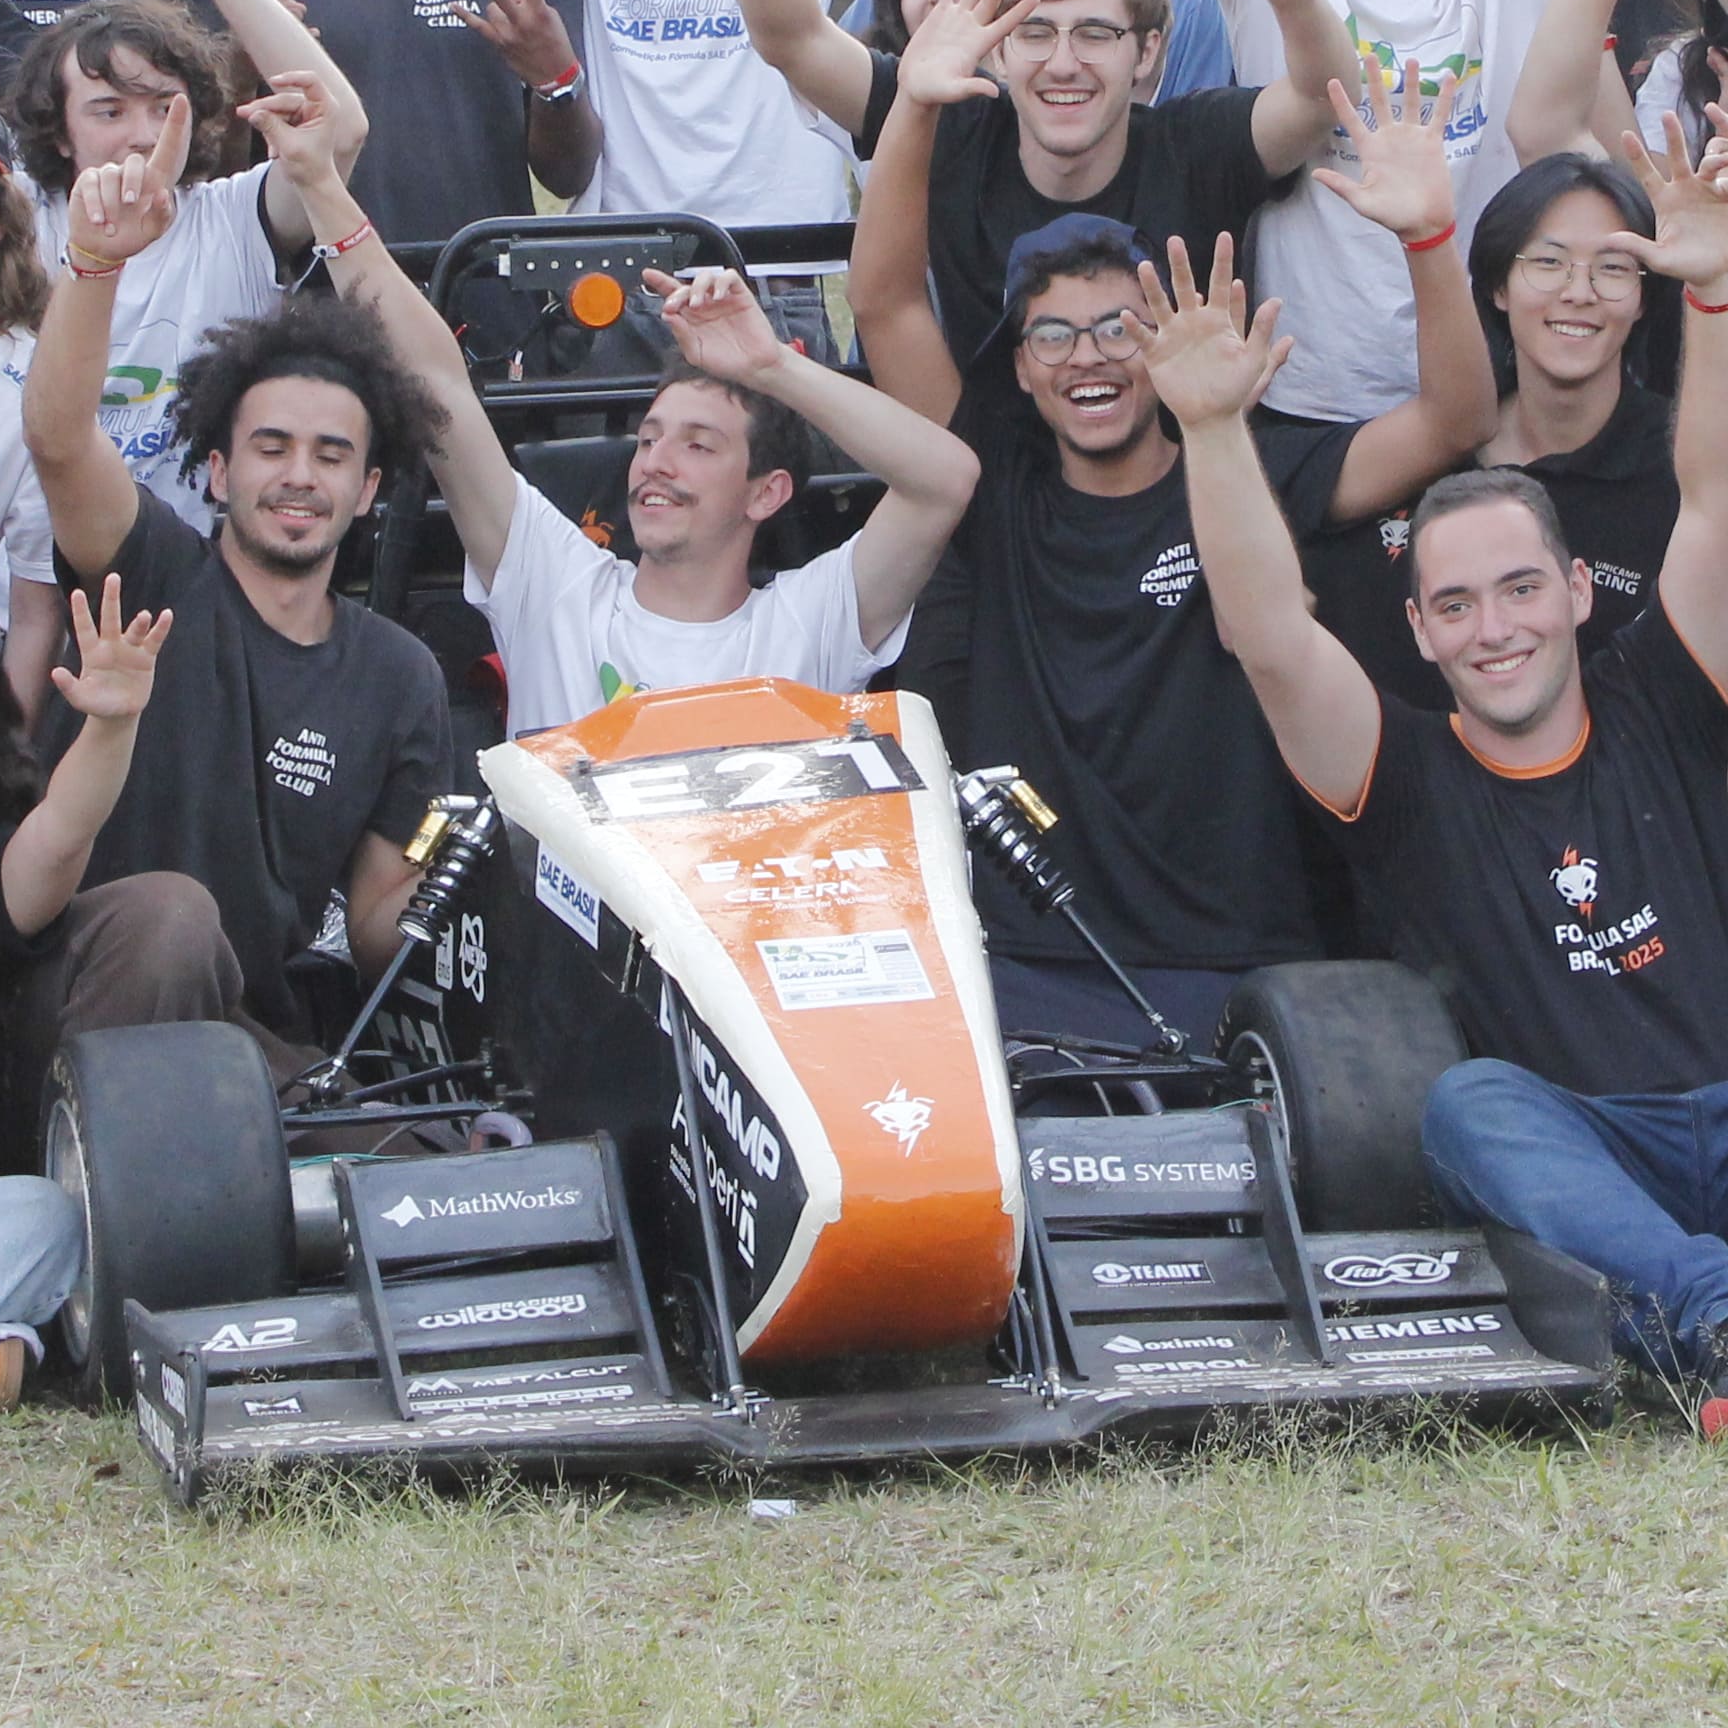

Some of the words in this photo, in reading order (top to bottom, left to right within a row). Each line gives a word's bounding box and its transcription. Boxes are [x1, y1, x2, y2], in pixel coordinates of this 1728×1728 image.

[606, 16, 656, 42] SAE
[662, 16, 745, 42] BRASIL
[1156, 542, 1191, 566] ANTI
[1594, 560, 1642, 580] UNICAMP
[297, 728, 327, 748] ANTI
[274, 736, 336, 769] FORMULA
[265, 750, 332, 786] FORMULA
[592, 740, 903, 819] E21
[275, 773, 316, 797] CLUB
[539, 853, 560, 892] SAE
[561, 874, 597, 924] BRASIL
[1554, 923, 1624, 952] FOULA
[1620, 904, 1658, 939] SAE
[1048, 1155, 1126, 1183] SBG
[1133, 1162, 1257, 1182] SYSTEMS
[1129, 1263, 1202, 1280] TEADIT
[472, 1364, 629, 1389] METALCUT
[1113, 1357, 1262, 1375] SPIROL
